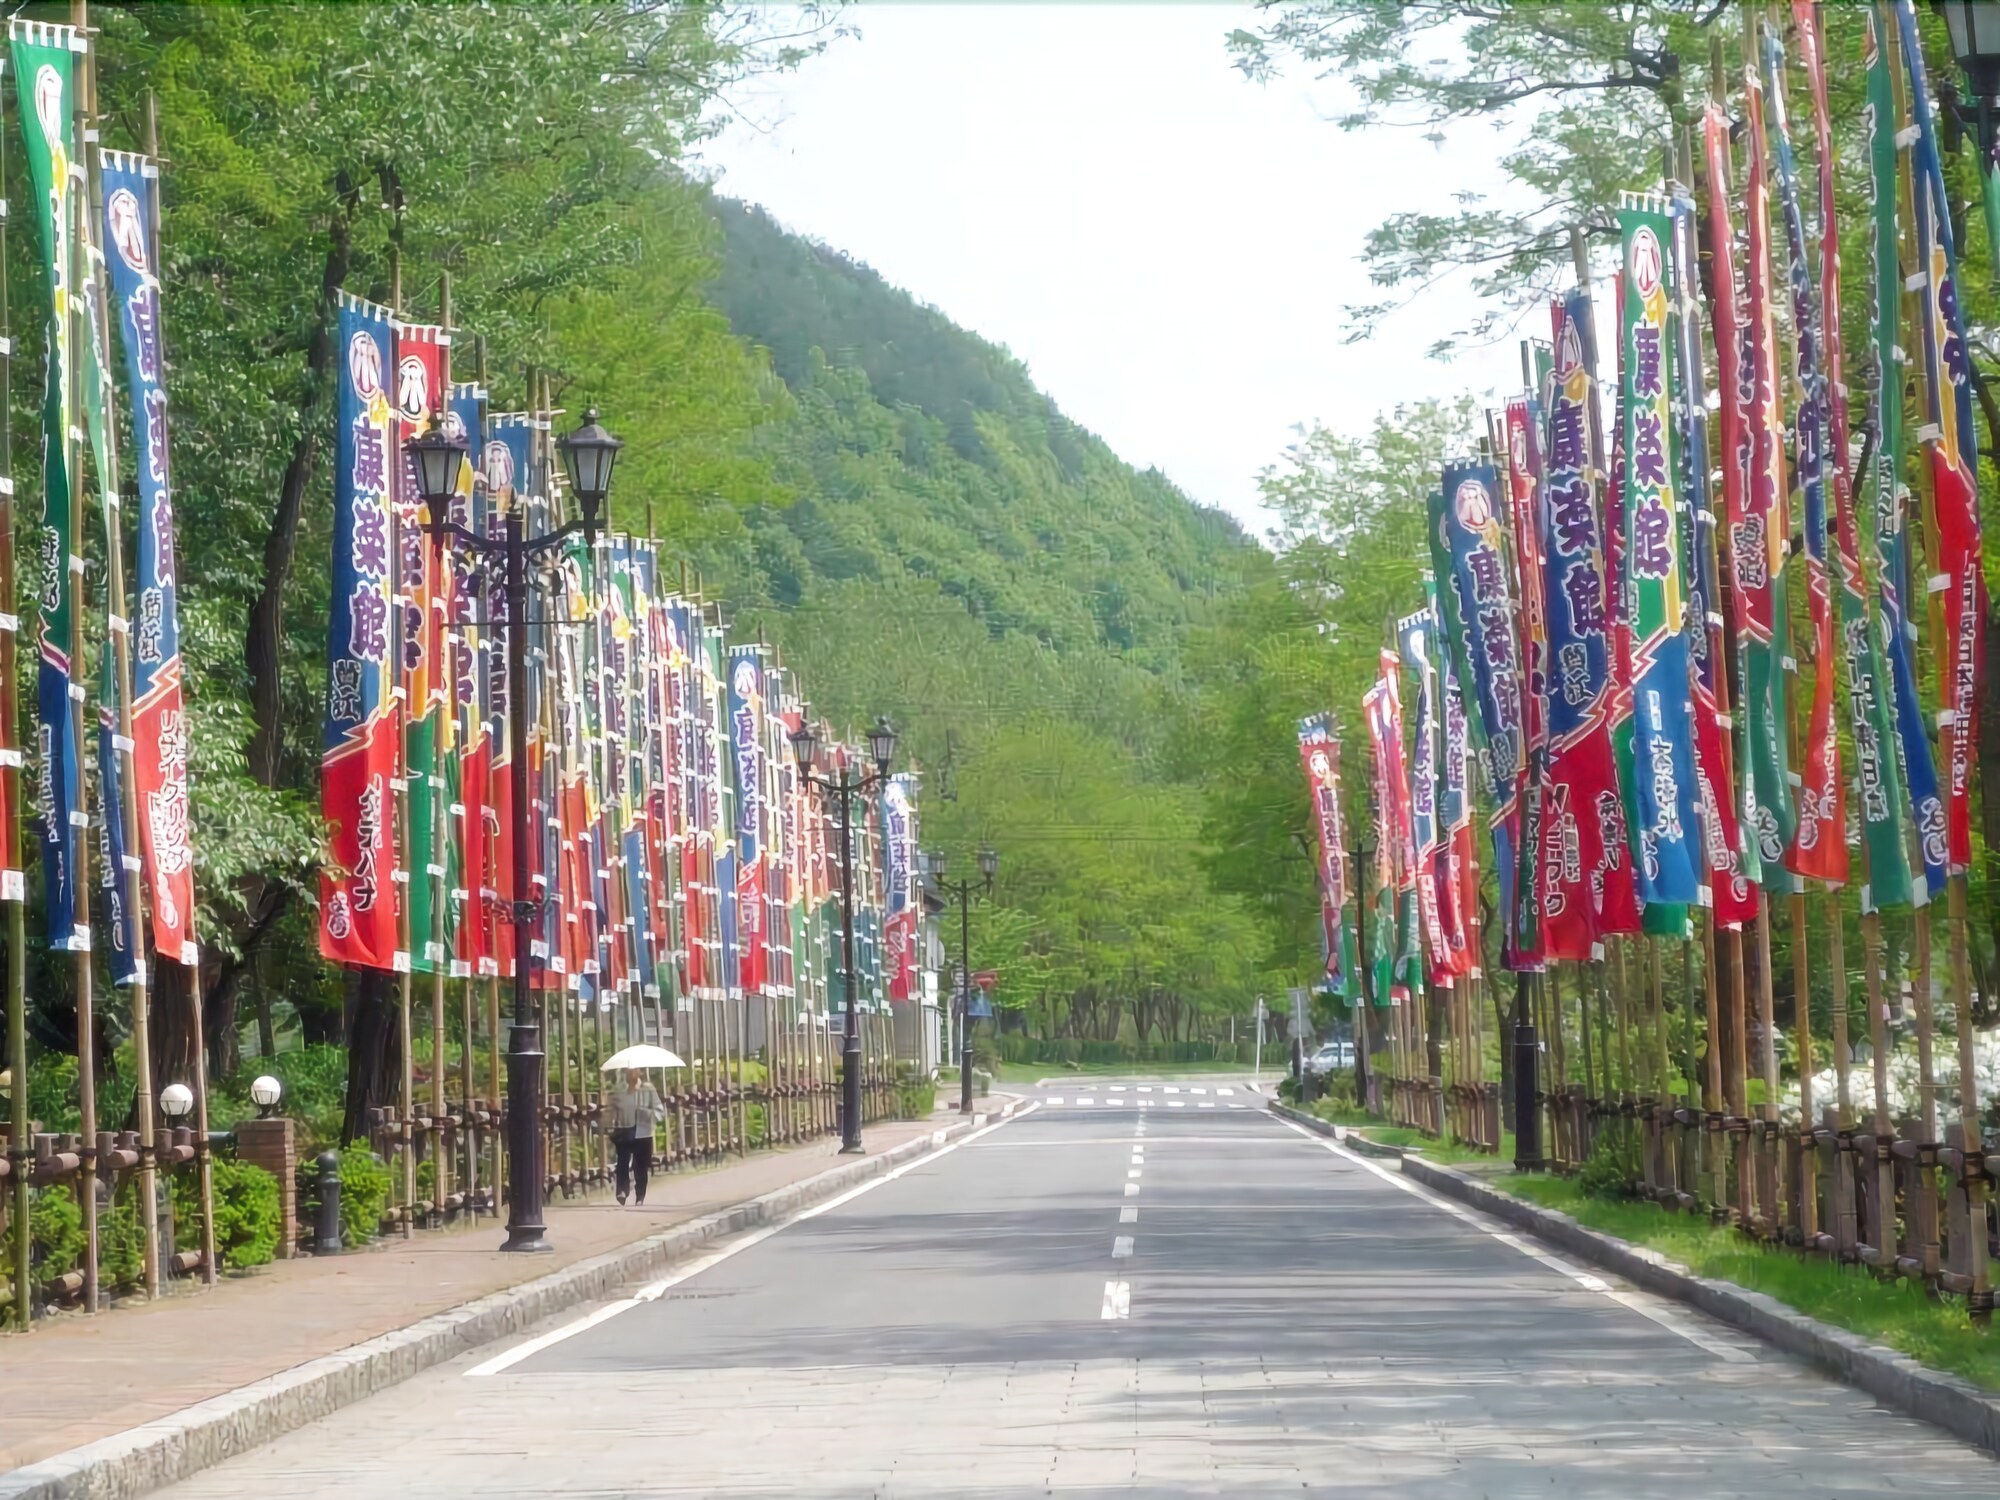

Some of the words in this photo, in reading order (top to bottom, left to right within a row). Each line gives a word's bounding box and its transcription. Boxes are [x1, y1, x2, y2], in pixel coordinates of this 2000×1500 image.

[351, 410, 389, 664] 康楽館
[1549, 396, 1608, 640] 康楽館
[1630, 318, 1673, 580] 康楽館
